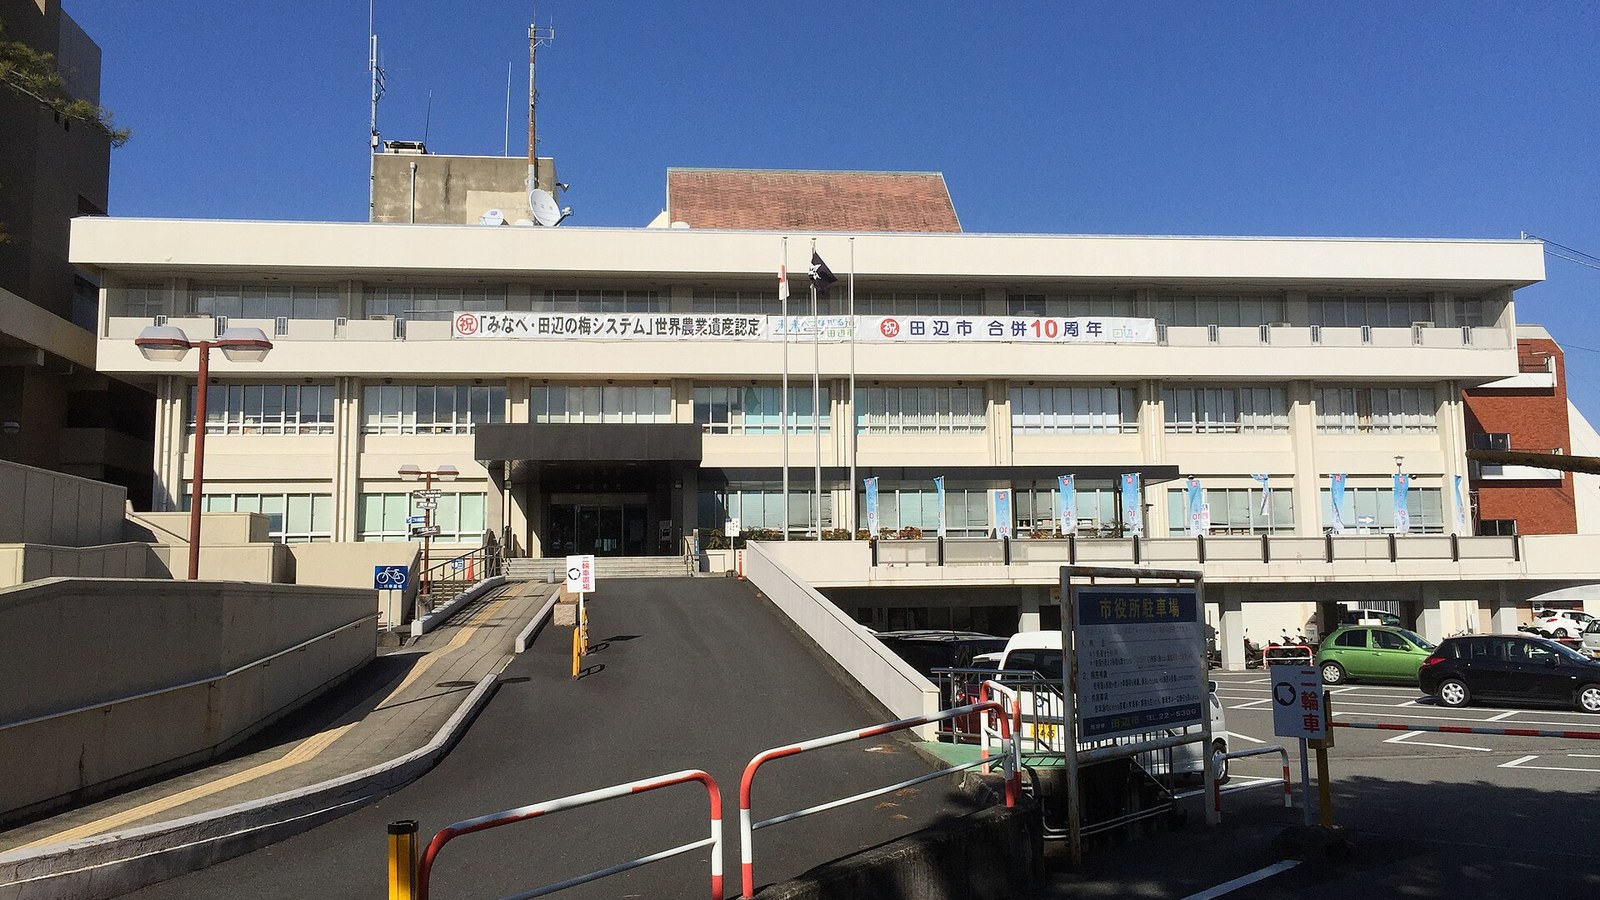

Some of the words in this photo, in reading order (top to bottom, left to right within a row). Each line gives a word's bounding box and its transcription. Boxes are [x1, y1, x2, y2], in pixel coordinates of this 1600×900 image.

[910, 320, 973, 336] 田辺市
[987, 319, 1103, 338] 合併10周年
[1100, 598, 1179, 619] 市役所駐車場
[1300, 670, 1320, 734] 二輪車
